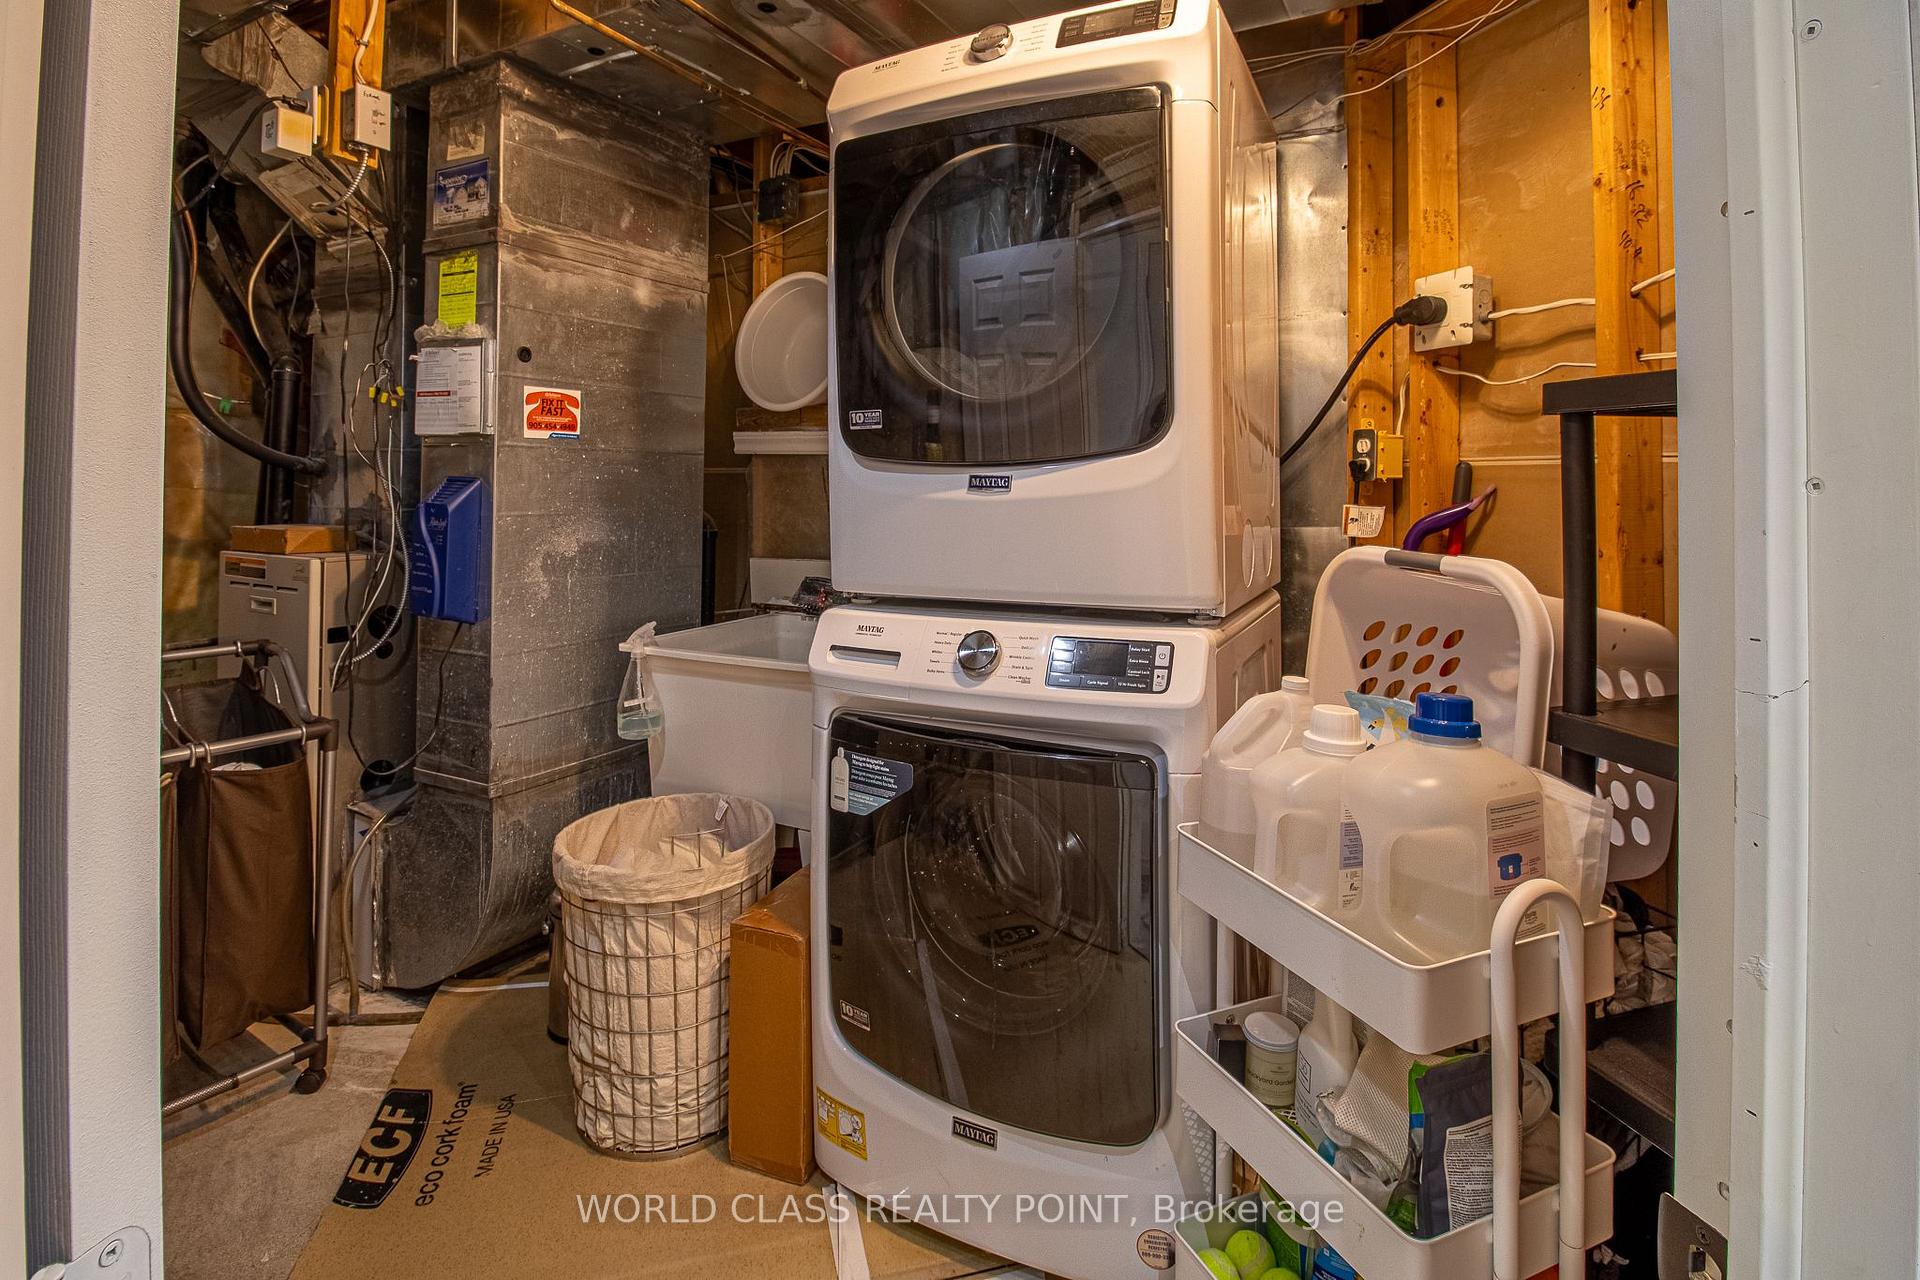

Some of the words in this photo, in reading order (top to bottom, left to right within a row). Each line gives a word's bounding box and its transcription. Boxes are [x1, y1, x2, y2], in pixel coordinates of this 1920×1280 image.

[541, 399, 555, 407] FIX
[541, 406, 565, 416] FAST
[851, 413, 864, 424] 10
[971, 478, 1009, 487] MAYTAG
[857, 625, 885, 634] MAYTAG
[842, 1003, 854, 1016] 10
[495, 1093, 517, 1120] USA
[489, 1121, 508, 1137] IN
[954, 1122, 994, 1145] MAYTAG
[346, 1104, 416, 1184] ECF
[474, 1137, 503, 1179] MADE
[415, 1169, 444, 1207] eco
[431, 1125, 463, 1168] cork
